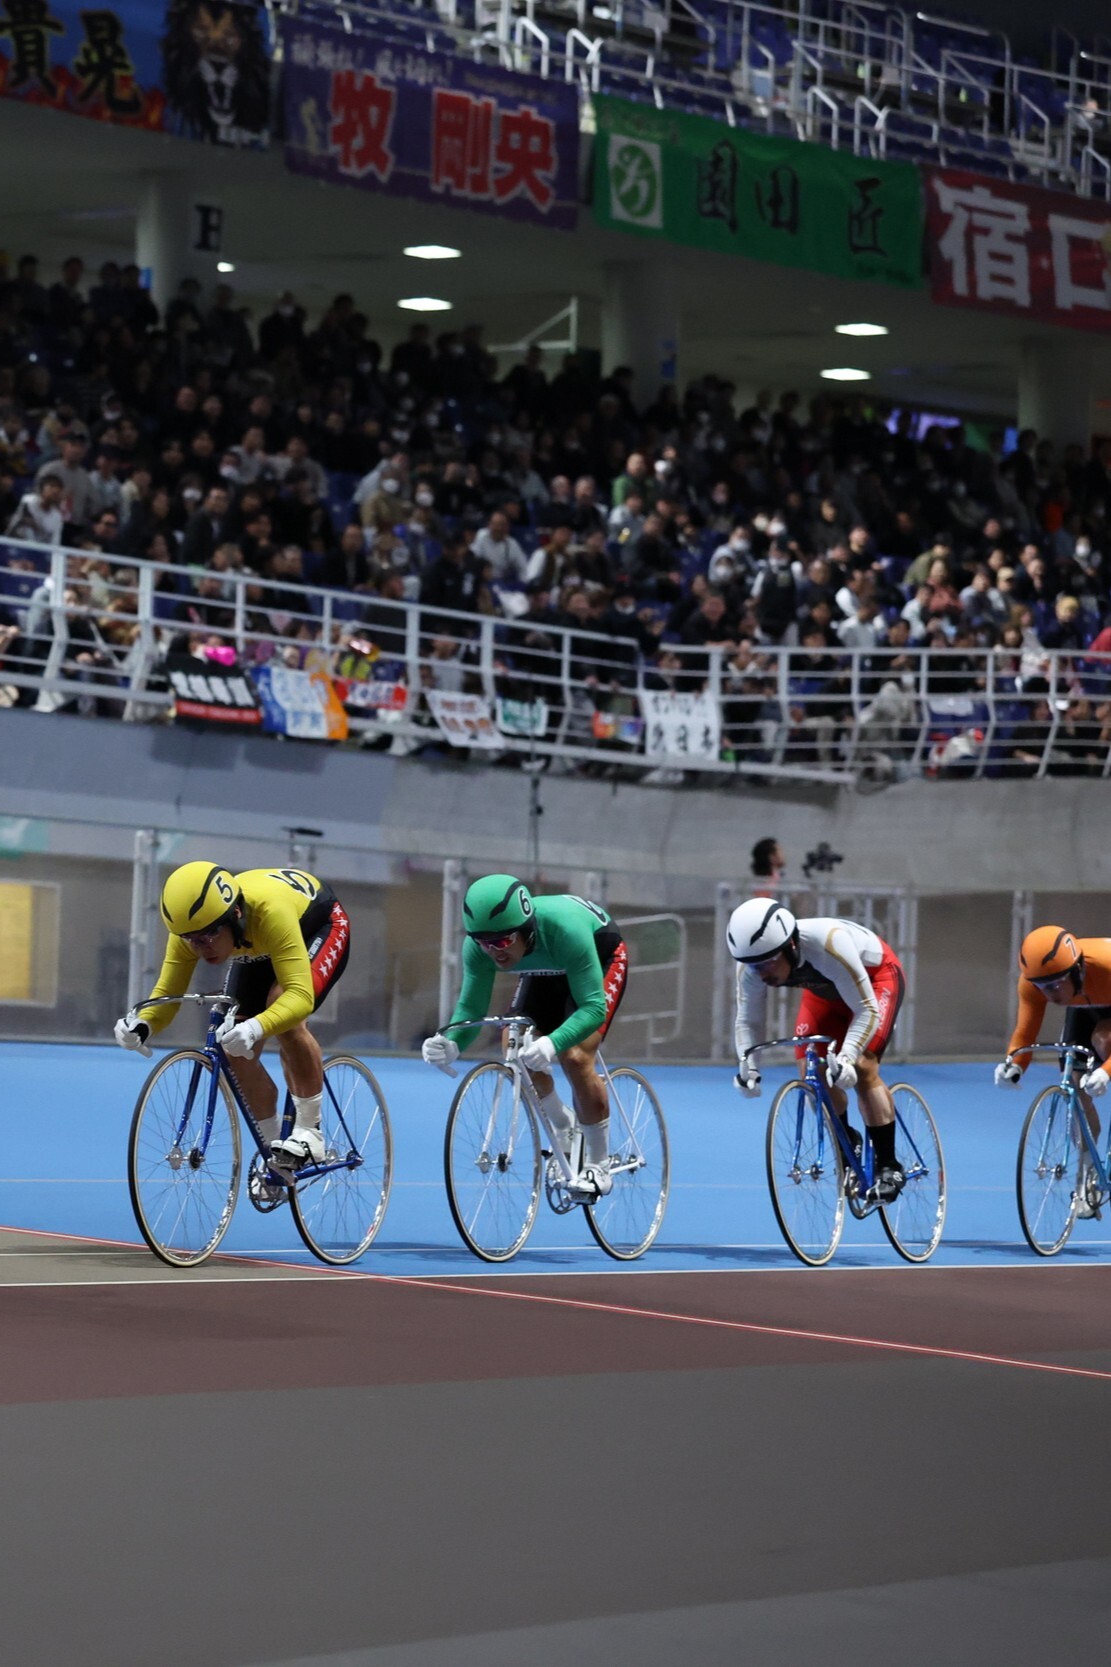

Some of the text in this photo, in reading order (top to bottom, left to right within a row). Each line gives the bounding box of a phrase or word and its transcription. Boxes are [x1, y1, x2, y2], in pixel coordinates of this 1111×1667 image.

[214, 875, 235, 905] 5
[517, 887, 534, 918] 6
[775, 913, 788, 937] 1
[1064, 936, 1079, 960] 7
